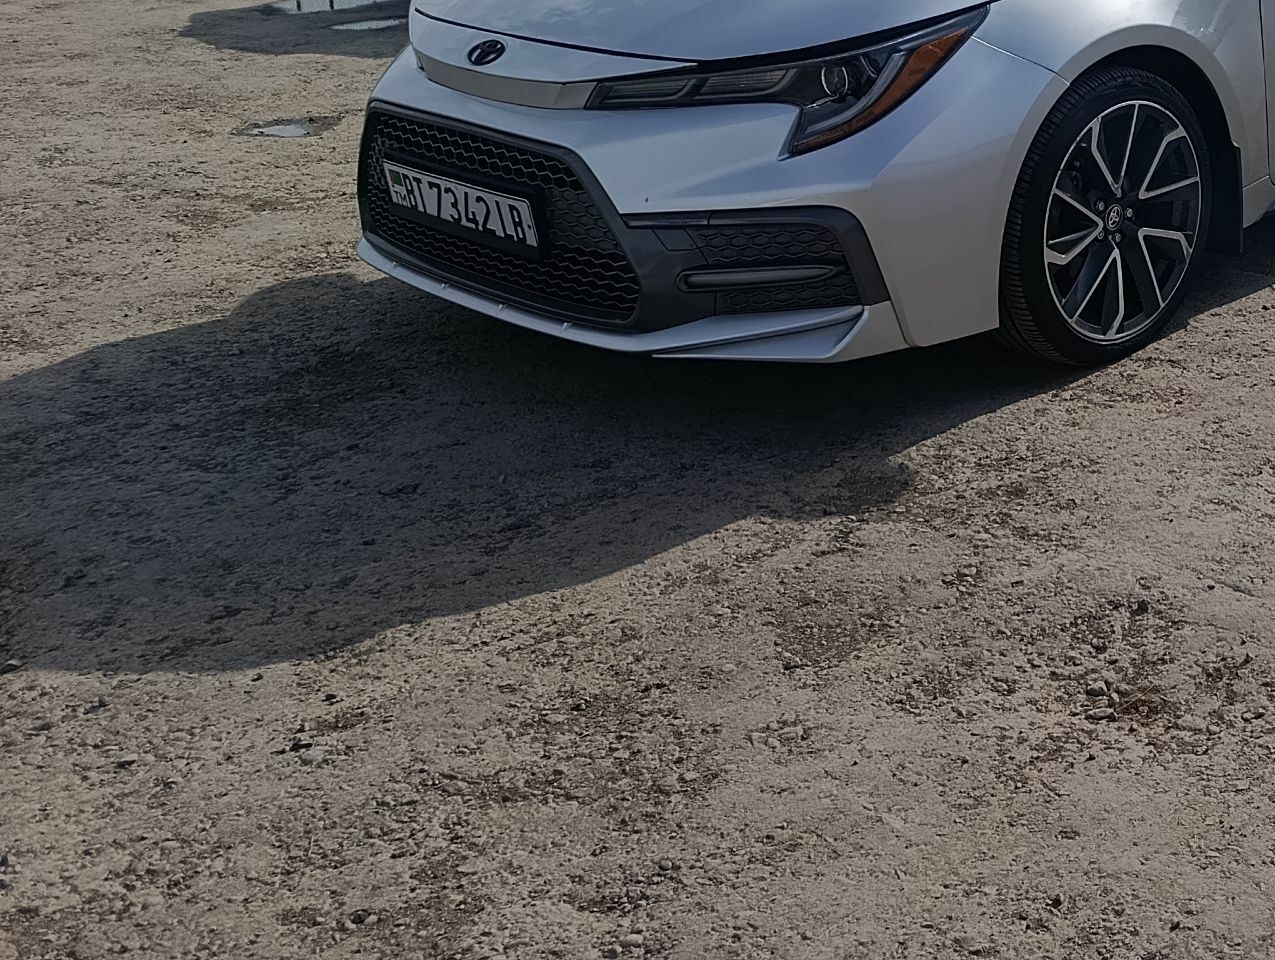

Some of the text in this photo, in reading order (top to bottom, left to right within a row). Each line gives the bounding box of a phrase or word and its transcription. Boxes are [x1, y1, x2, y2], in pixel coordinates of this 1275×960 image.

[392, 189, 411, 208] TM
[402, 172, 527, 244] BT 7342 LB
